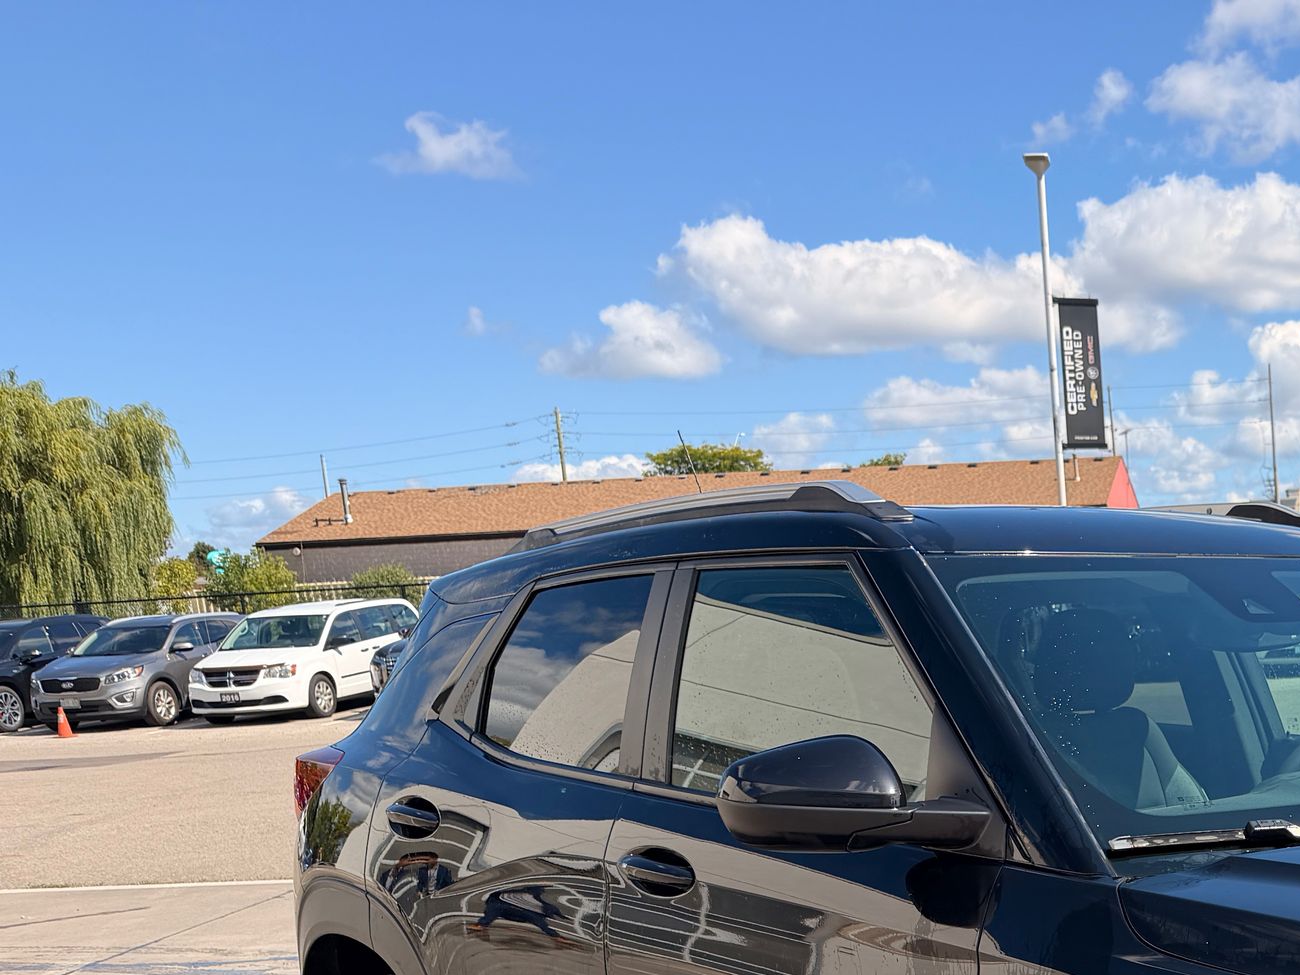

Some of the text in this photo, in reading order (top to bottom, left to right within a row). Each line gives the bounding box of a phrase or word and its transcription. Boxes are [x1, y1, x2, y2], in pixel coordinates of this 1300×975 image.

[1062, 326, 1077, 415] CERTIFIED
[1073, 330, 1086, 411] PRE-OWNED
[1087, 335, 1095, 364] GMC
